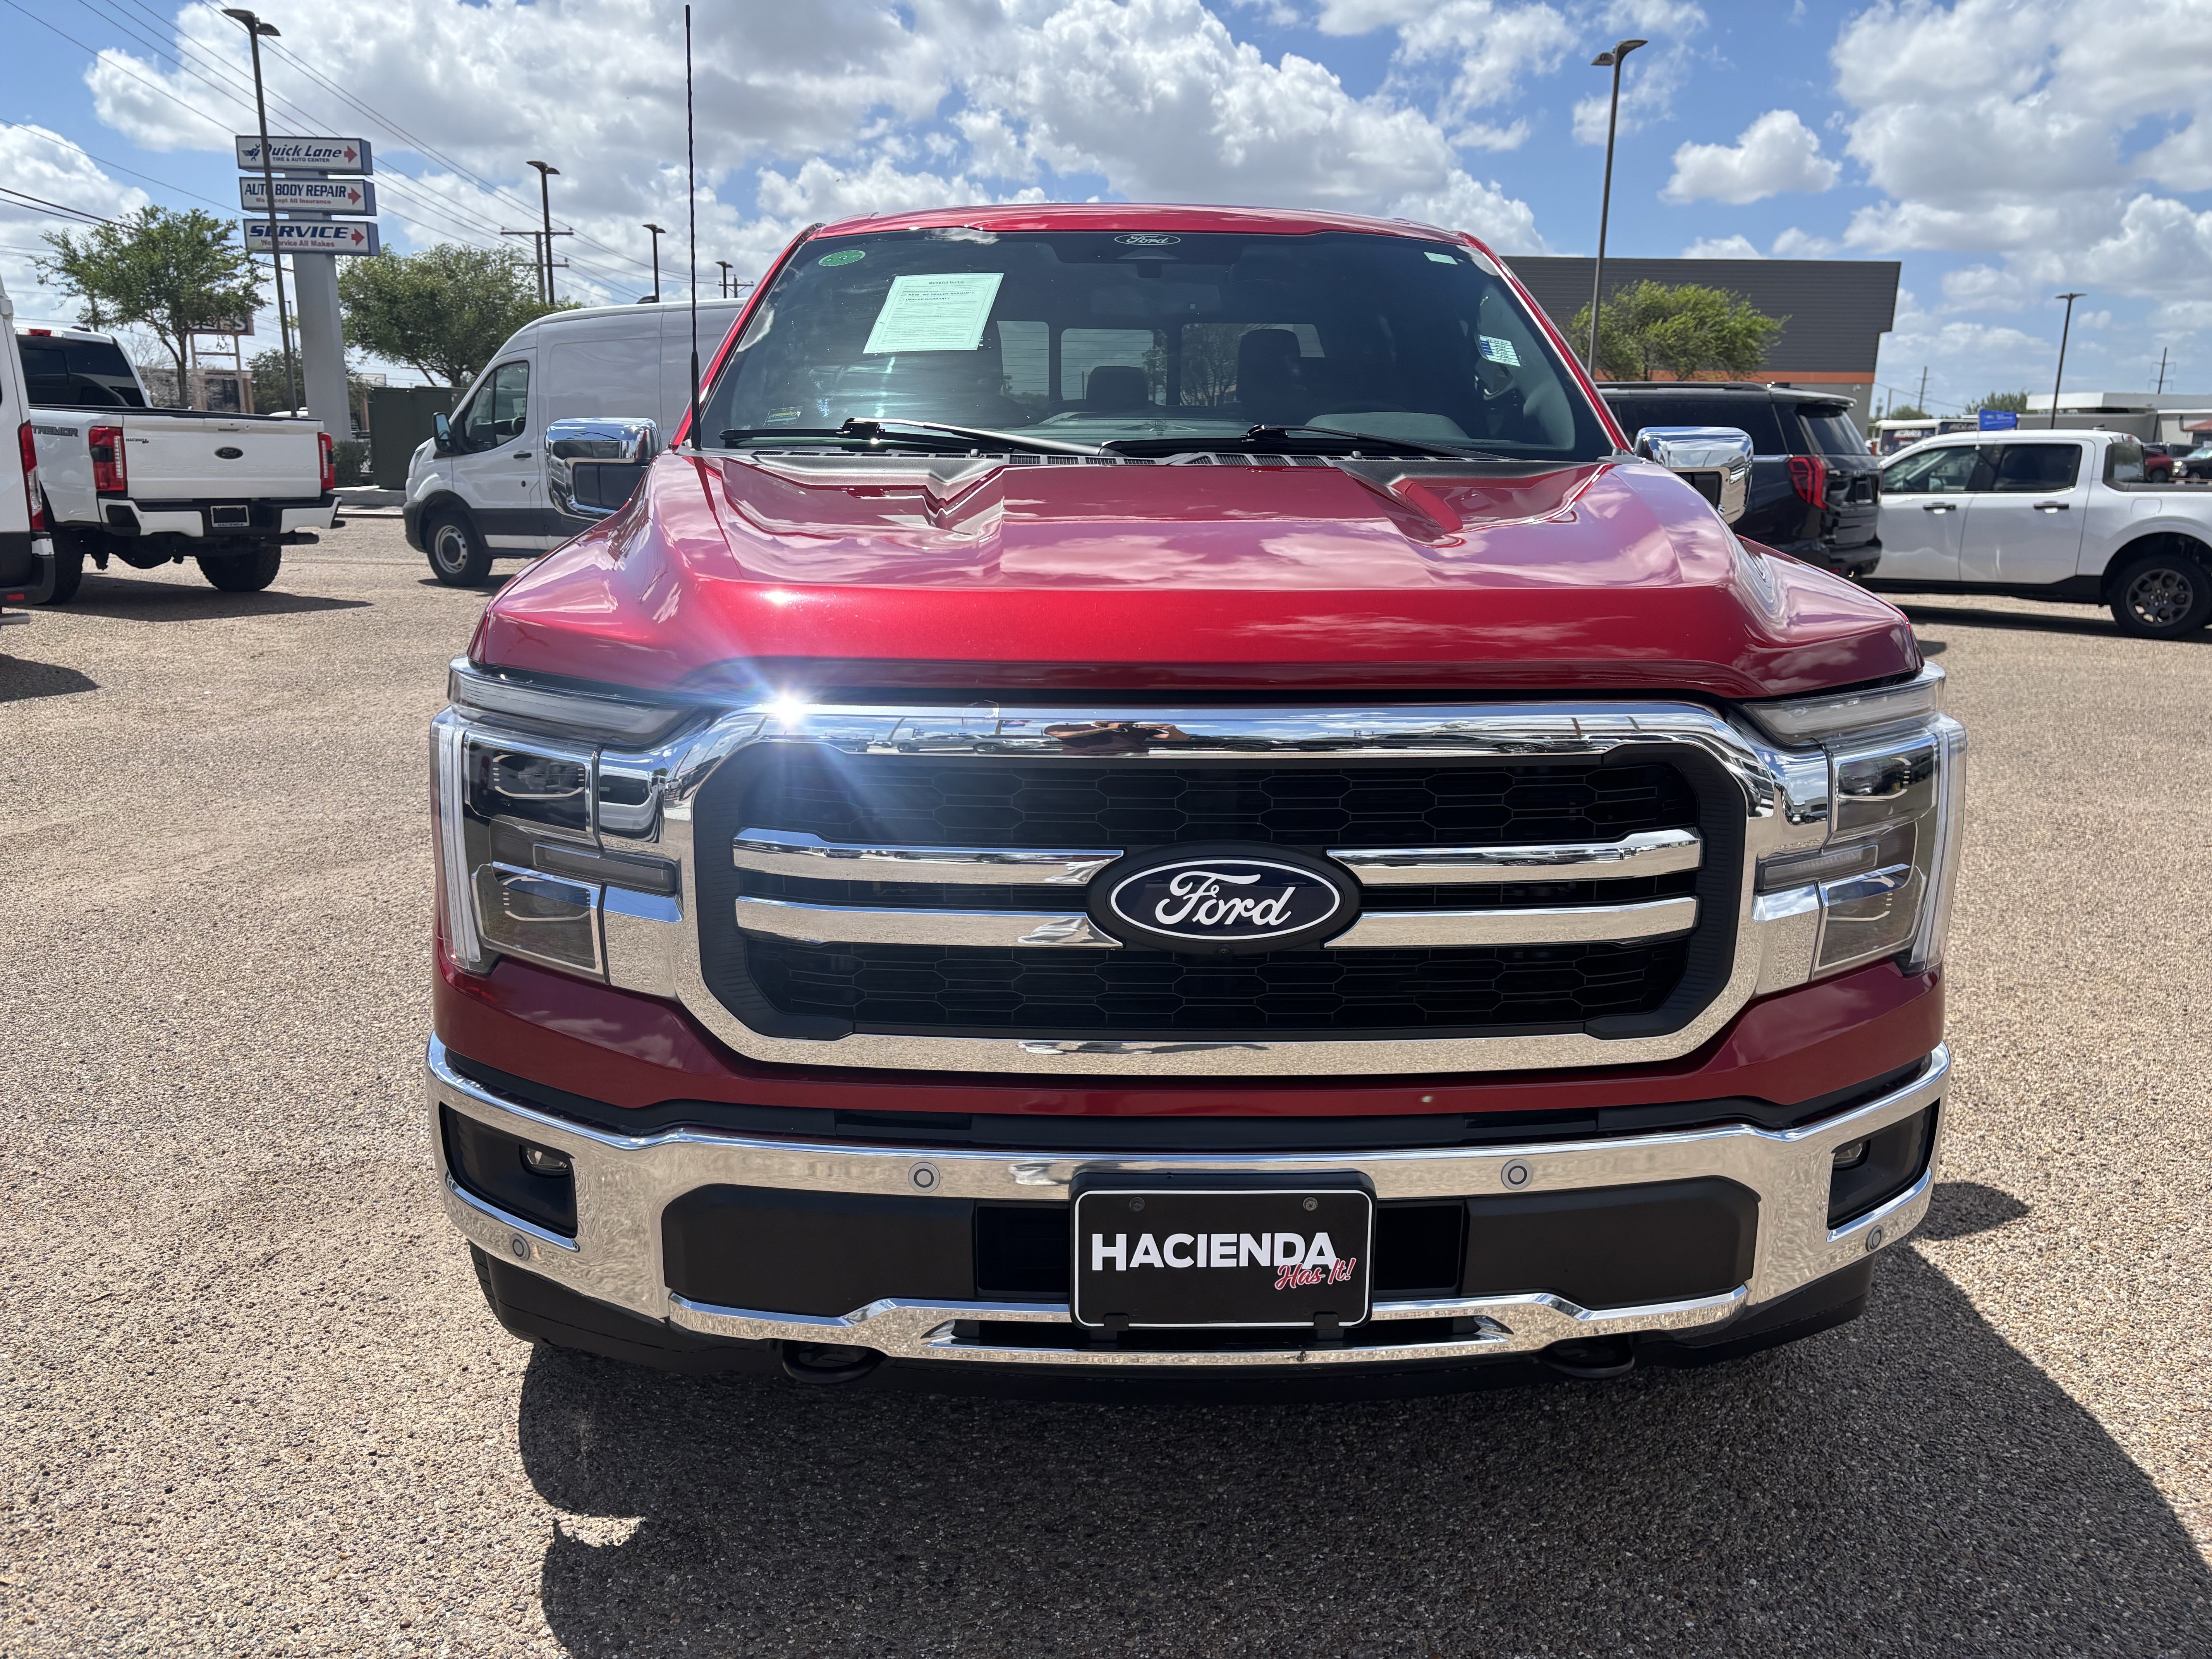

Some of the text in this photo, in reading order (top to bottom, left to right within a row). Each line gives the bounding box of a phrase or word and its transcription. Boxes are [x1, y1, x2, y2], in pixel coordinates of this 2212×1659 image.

[304, 145, 342, 158] Lane
[244, 183, 346, 198] AUT BODY REPAIR
[1126, 235, 1169, 244] Ford
[32, 426, 79, 437] TREMOR
[1155, 871, 1297, 926] Ford
[1092, 1232, 1337, 1271] HACIENDA
[1274, 1257, 1357, 1290] Has It!
